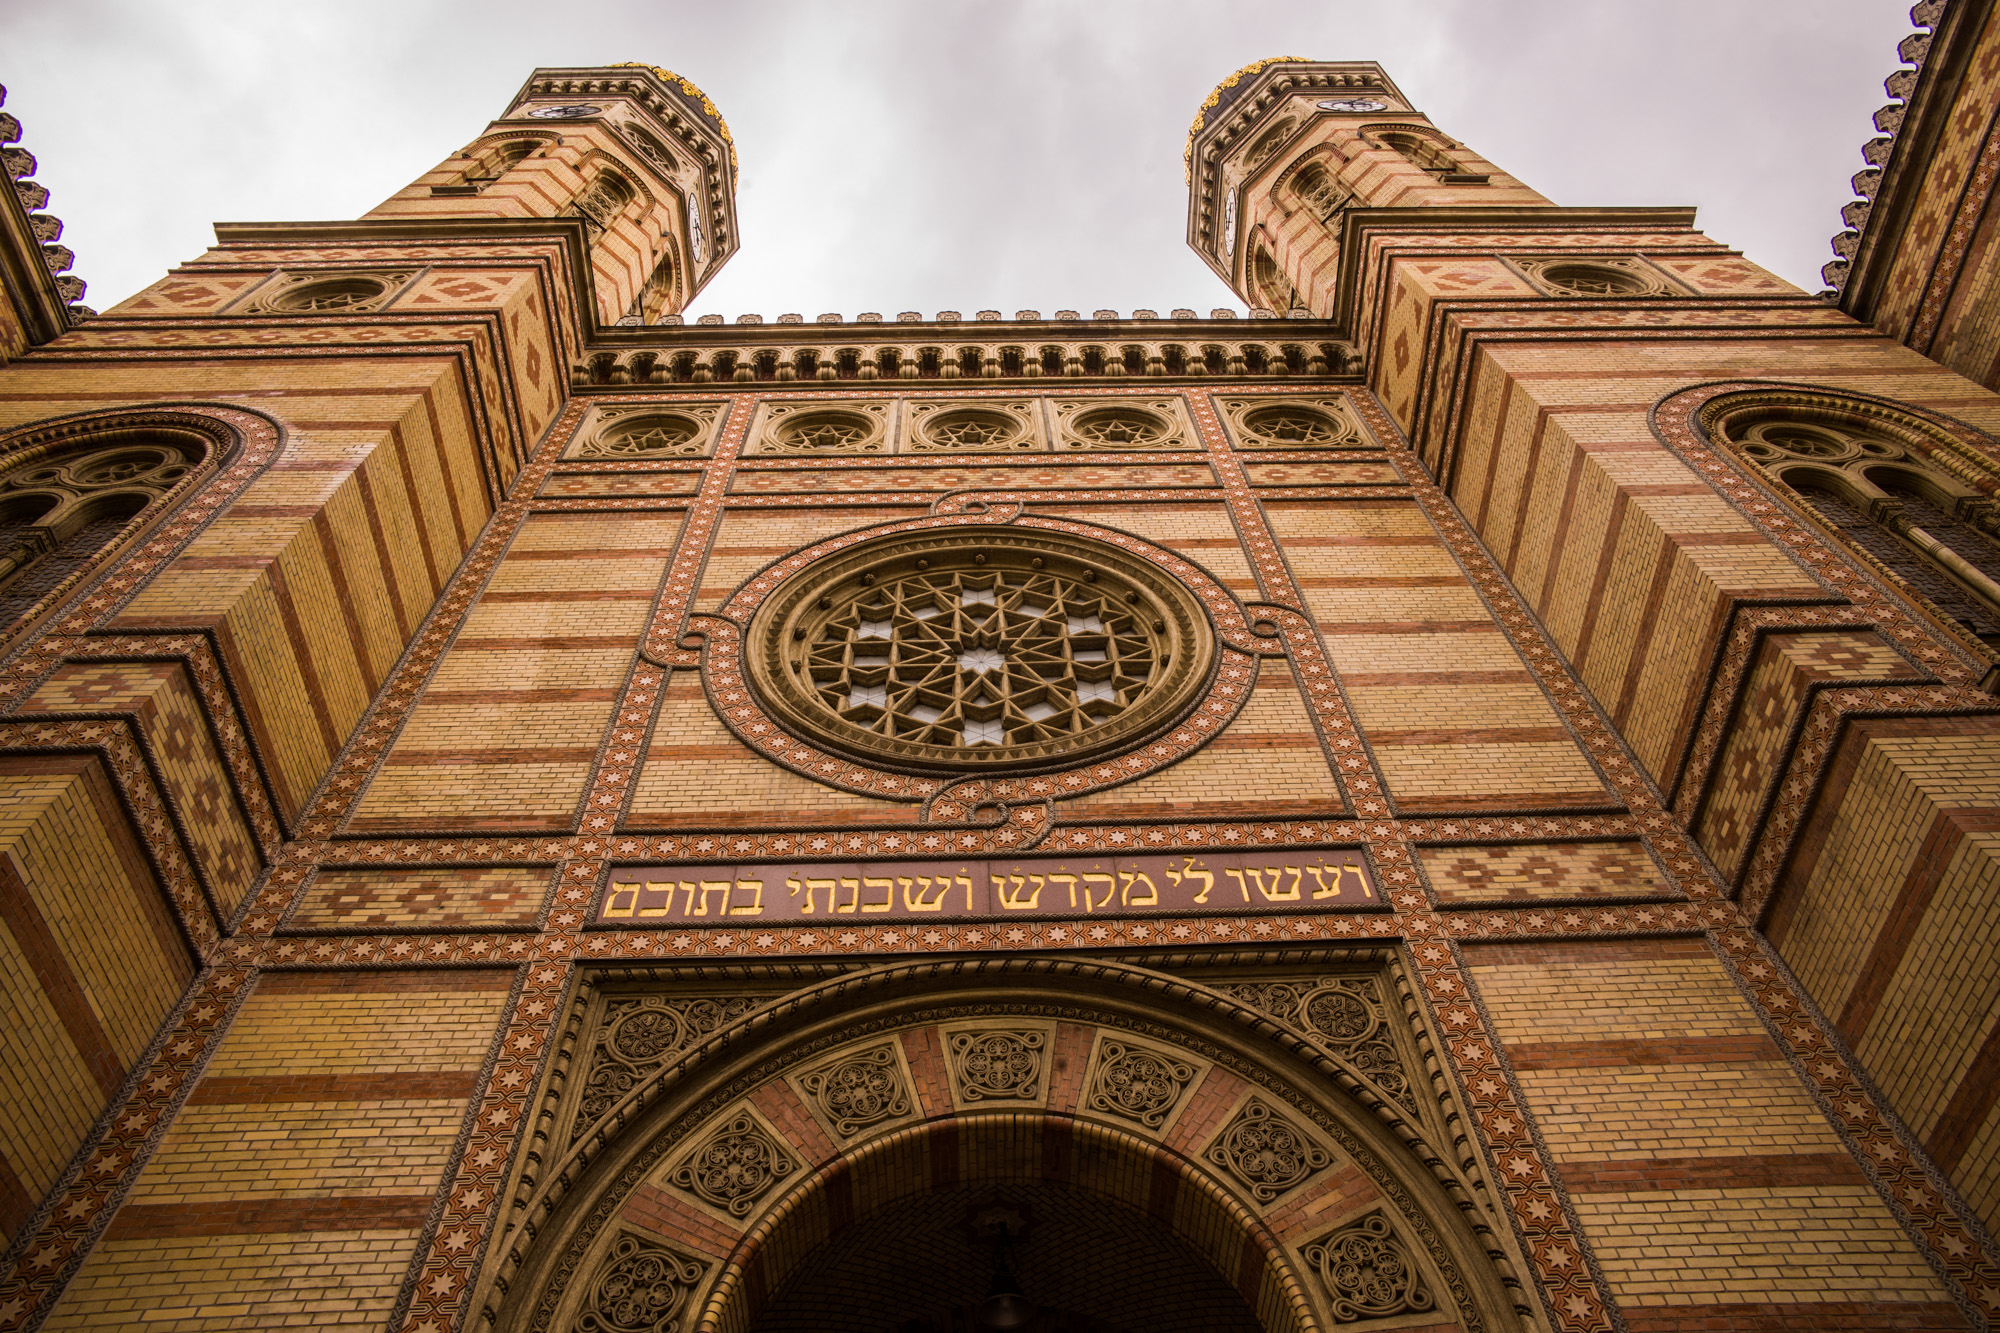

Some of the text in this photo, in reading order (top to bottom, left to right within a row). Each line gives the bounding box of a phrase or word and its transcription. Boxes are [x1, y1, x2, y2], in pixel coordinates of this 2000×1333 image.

[602, 855, 1372, 919] ועשו לי מקדש ושכנתי בתוכם
